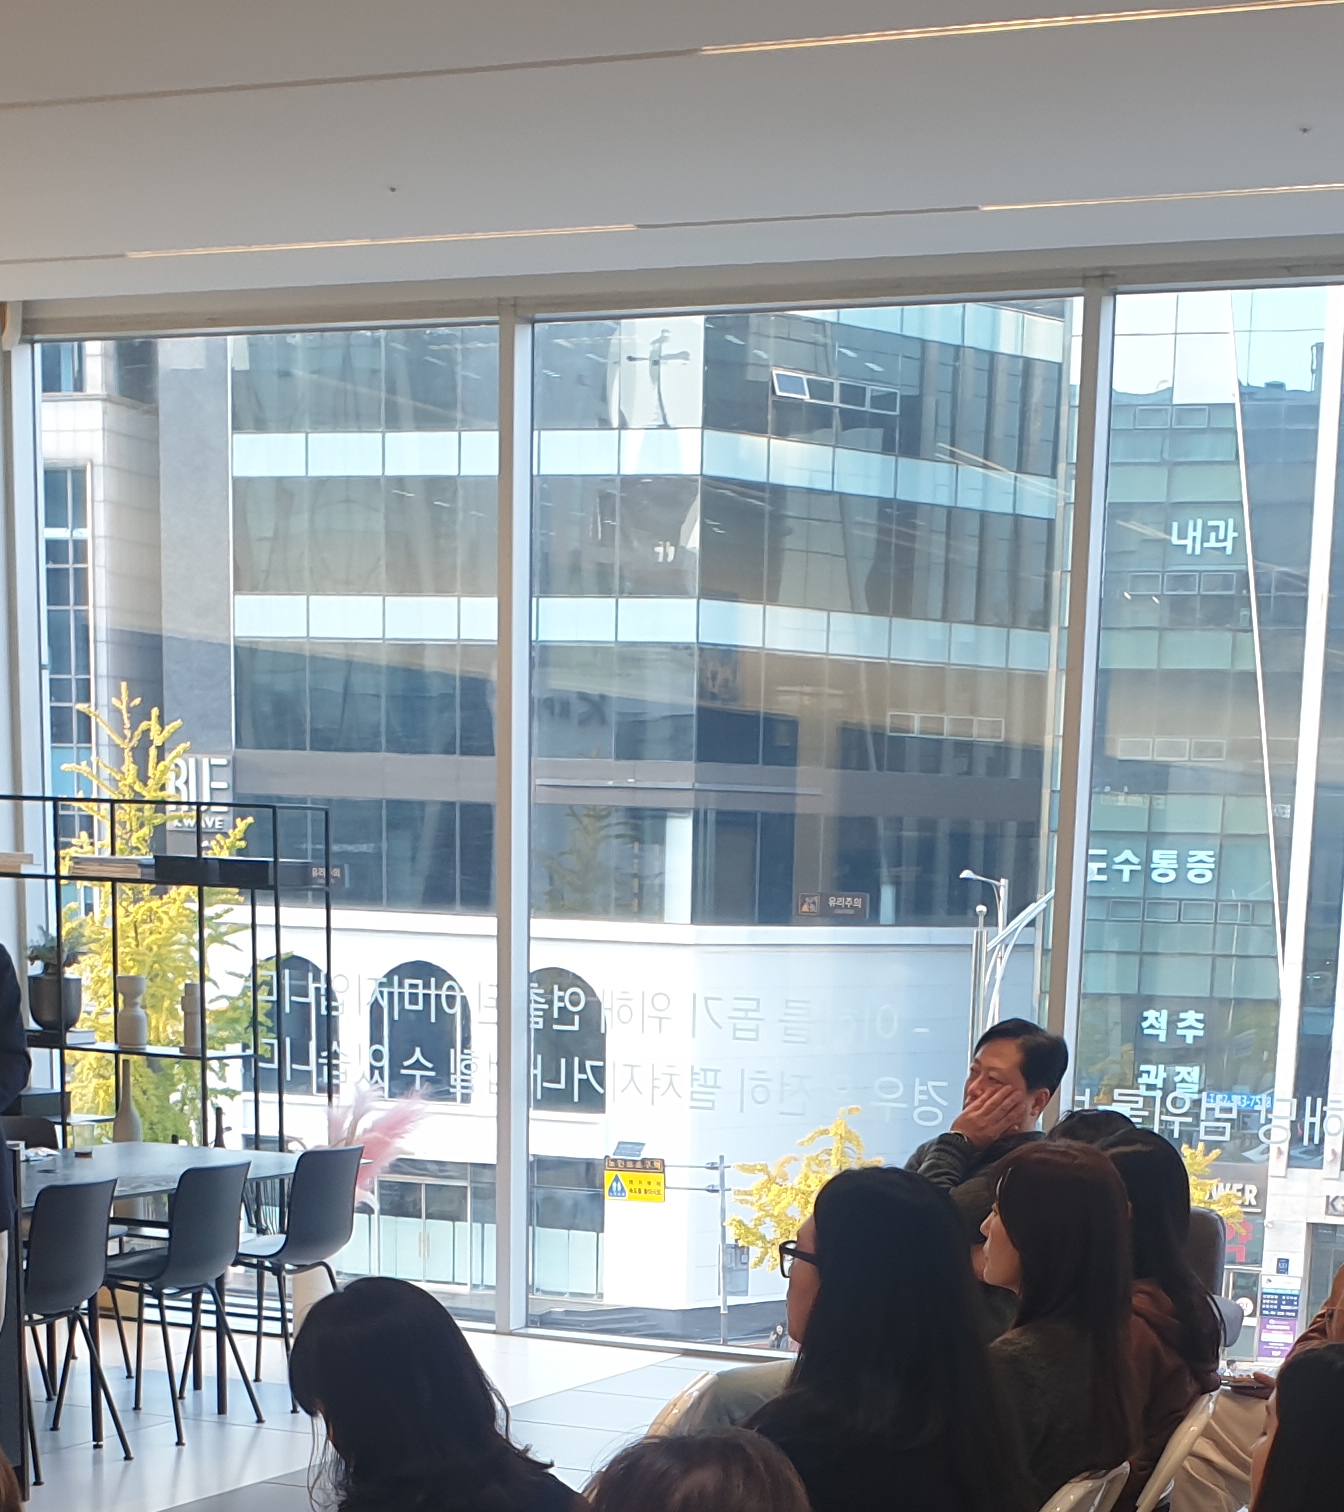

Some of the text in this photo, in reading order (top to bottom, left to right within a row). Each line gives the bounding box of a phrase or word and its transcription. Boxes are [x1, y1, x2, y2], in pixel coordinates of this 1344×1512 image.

[1171, 518, 1239, 555] 내과
[828, 896, 862, 909] 유리주의
[1141, 1009, 1205, 1044] 척추
[1137, 1064, 1203, 1100] 관절
